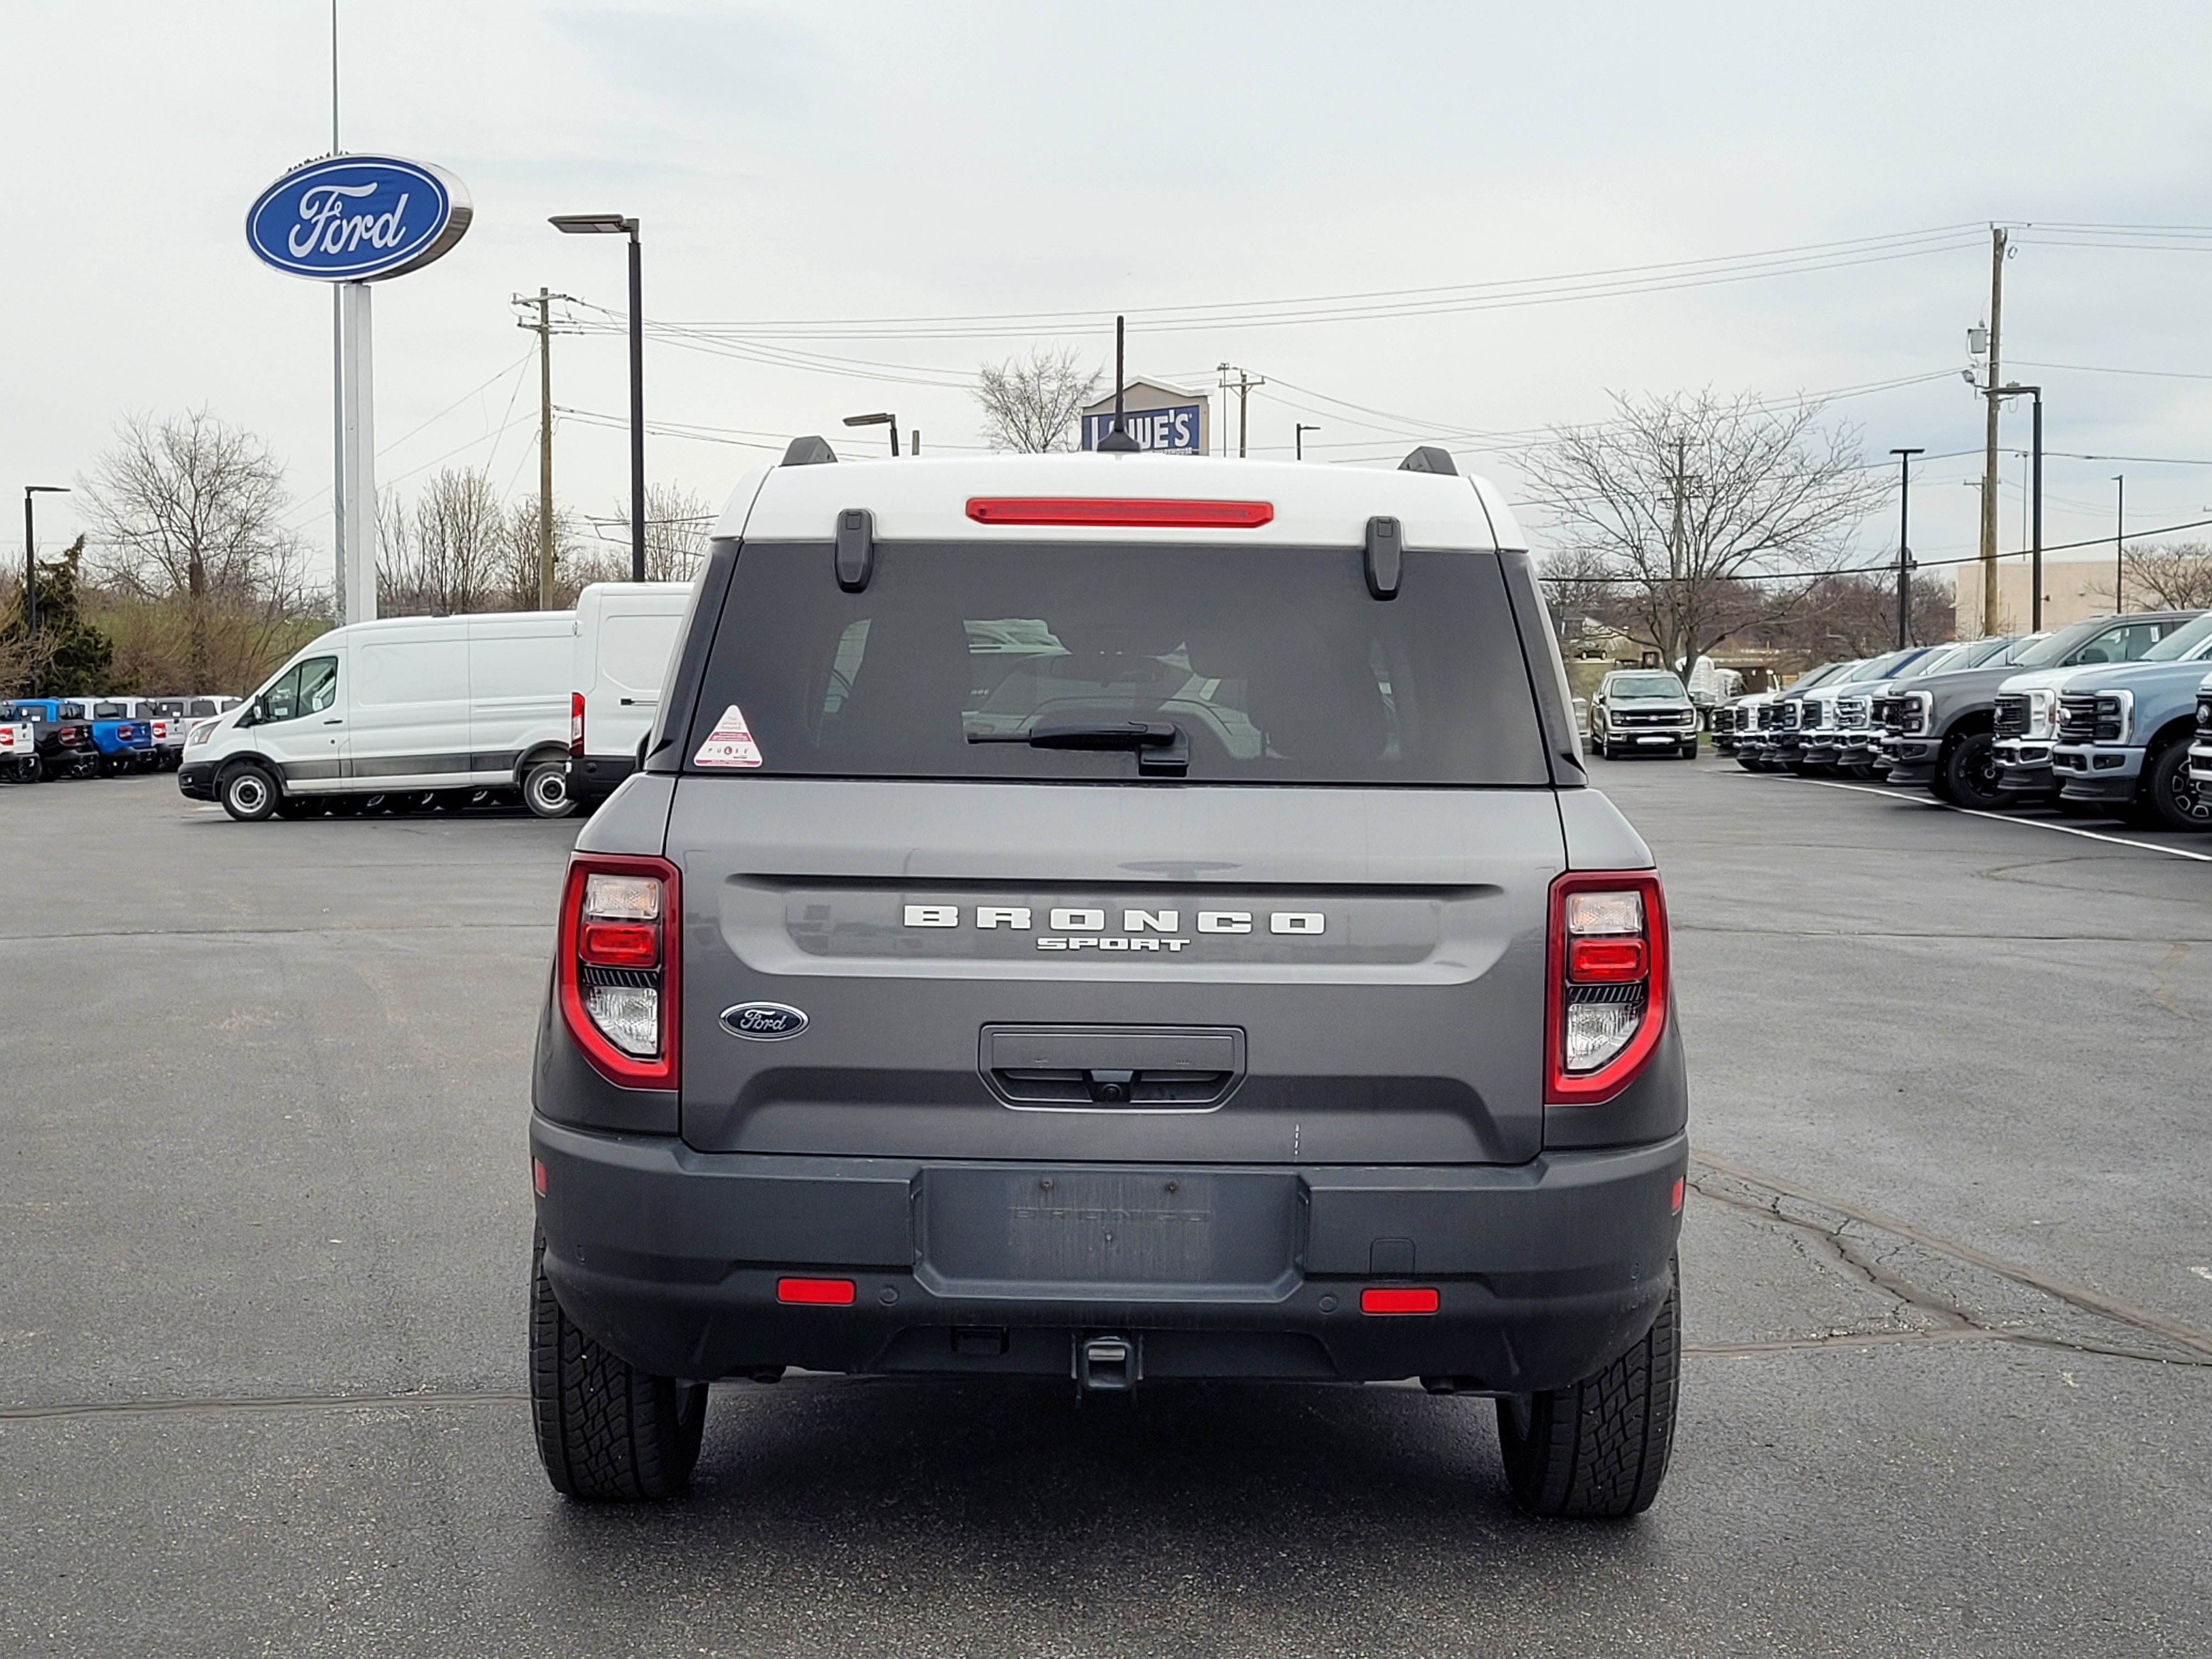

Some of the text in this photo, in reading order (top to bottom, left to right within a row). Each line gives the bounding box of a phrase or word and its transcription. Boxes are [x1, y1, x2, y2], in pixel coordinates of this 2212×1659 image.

[288, 182, 409, 258] Ford
[1091, 409, 1190, 450] LWE'S
[903, 905, 1325, 934] BRONCO
[1037, 938, 1190, 952] SPORT
[740, 1009, 788, 1030] Ford
